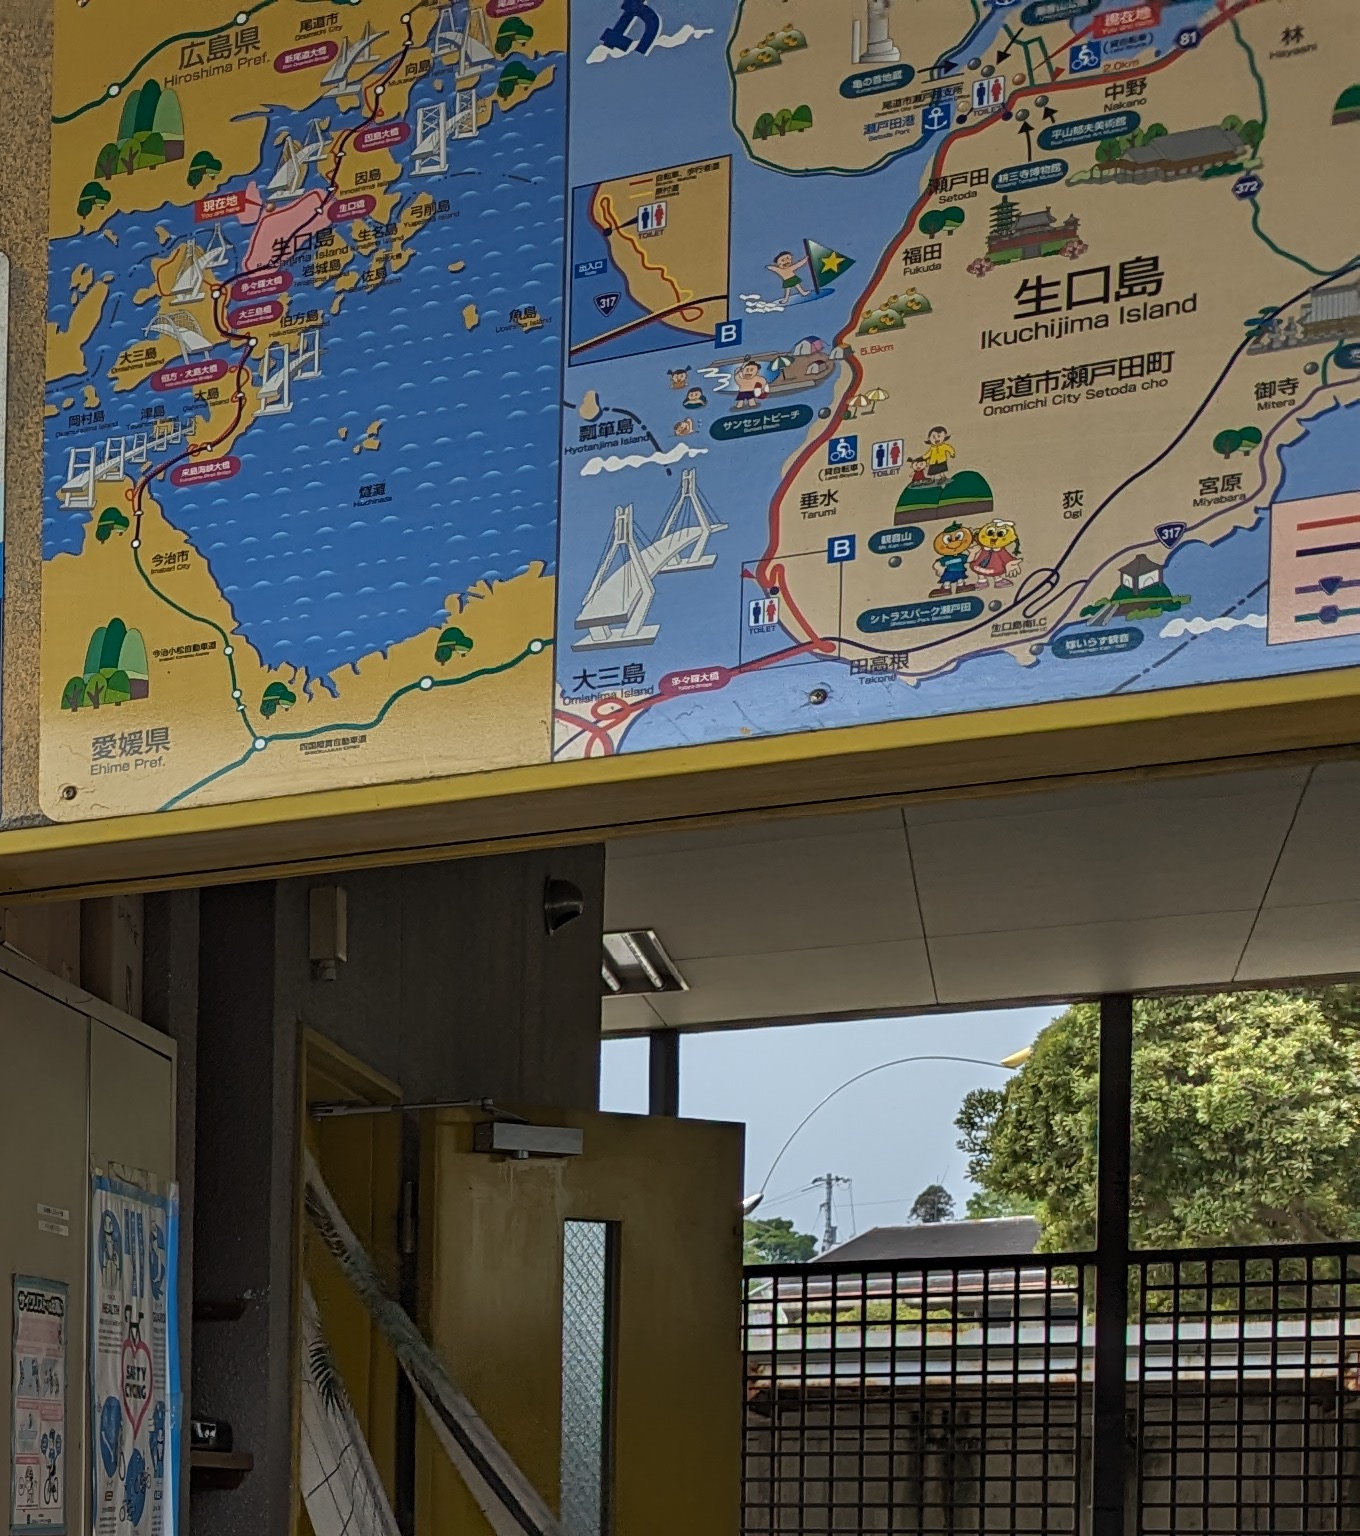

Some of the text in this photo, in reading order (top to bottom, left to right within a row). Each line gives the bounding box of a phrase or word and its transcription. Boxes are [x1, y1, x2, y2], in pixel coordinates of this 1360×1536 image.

[1179, 31, 1198, 46] 81
[1281, 25, 1305, 46] 林
[178, 26, 261, 70] 広島県
[164, 63, 233, 88] Hiroshima
[237, 52, 271, 71] Pref.
[1104, 77, 1147, 100] 中野
[928, 168, 989, 195] 瀬戸田
[1234, 180, 1260, 194] 372
[902, 242, 943, 265] 福田
[1013, 255, 1165, 319] 生口島
[599, 296, 616, 309] 317
[980, 293, 1198, 350] Ikuchijima Island
[720, 325, 737, 342] B
[119, 349, 157, 365] 大三島
[979, 350, 1175, 404] 尾道市瀬戸田町
[194, 387, 220, 402] 大島
[983, 377, 1169, 417] Onomichi City Setoda cho
[1254, 377, 1299, 401] 御寺
[722, 409, 801, 432] サンセットビーチ
[1198, 472, 1243, 496] 宮原
[799, 489, 839, 509] 垂水
[1161, 527, 1181, 540] 317
[151, 550, 189, 567] 今治市
[834, 540, 850, 557] B
[572, 662, 646, 692] 大三島
[619, 684, 655, 700] Island
[91, 727, 172, 761] 愛媛県
[90, 757, 167, 776] Ehime Pref.
